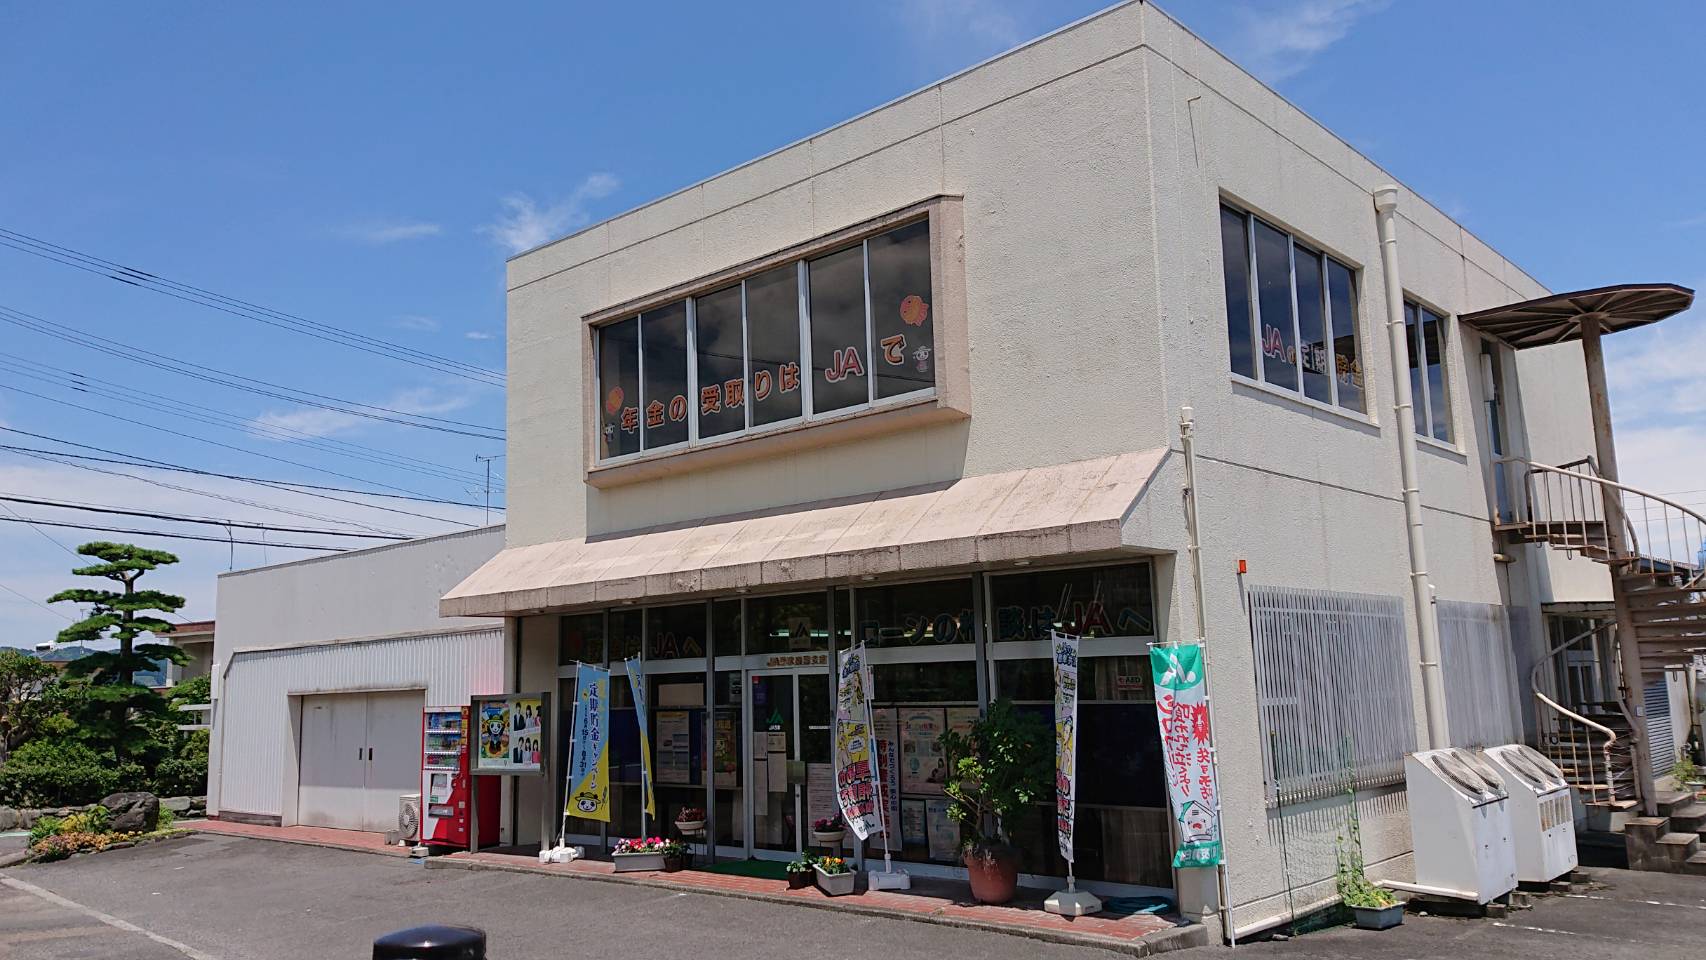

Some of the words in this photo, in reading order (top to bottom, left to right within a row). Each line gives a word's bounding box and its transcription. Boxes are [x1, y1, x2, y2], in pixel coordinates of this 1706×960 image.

[621, 334, 906, 433] 年金の受取りはJAで
[588, 683, 600, 790] 定期貯金キャンペーン
